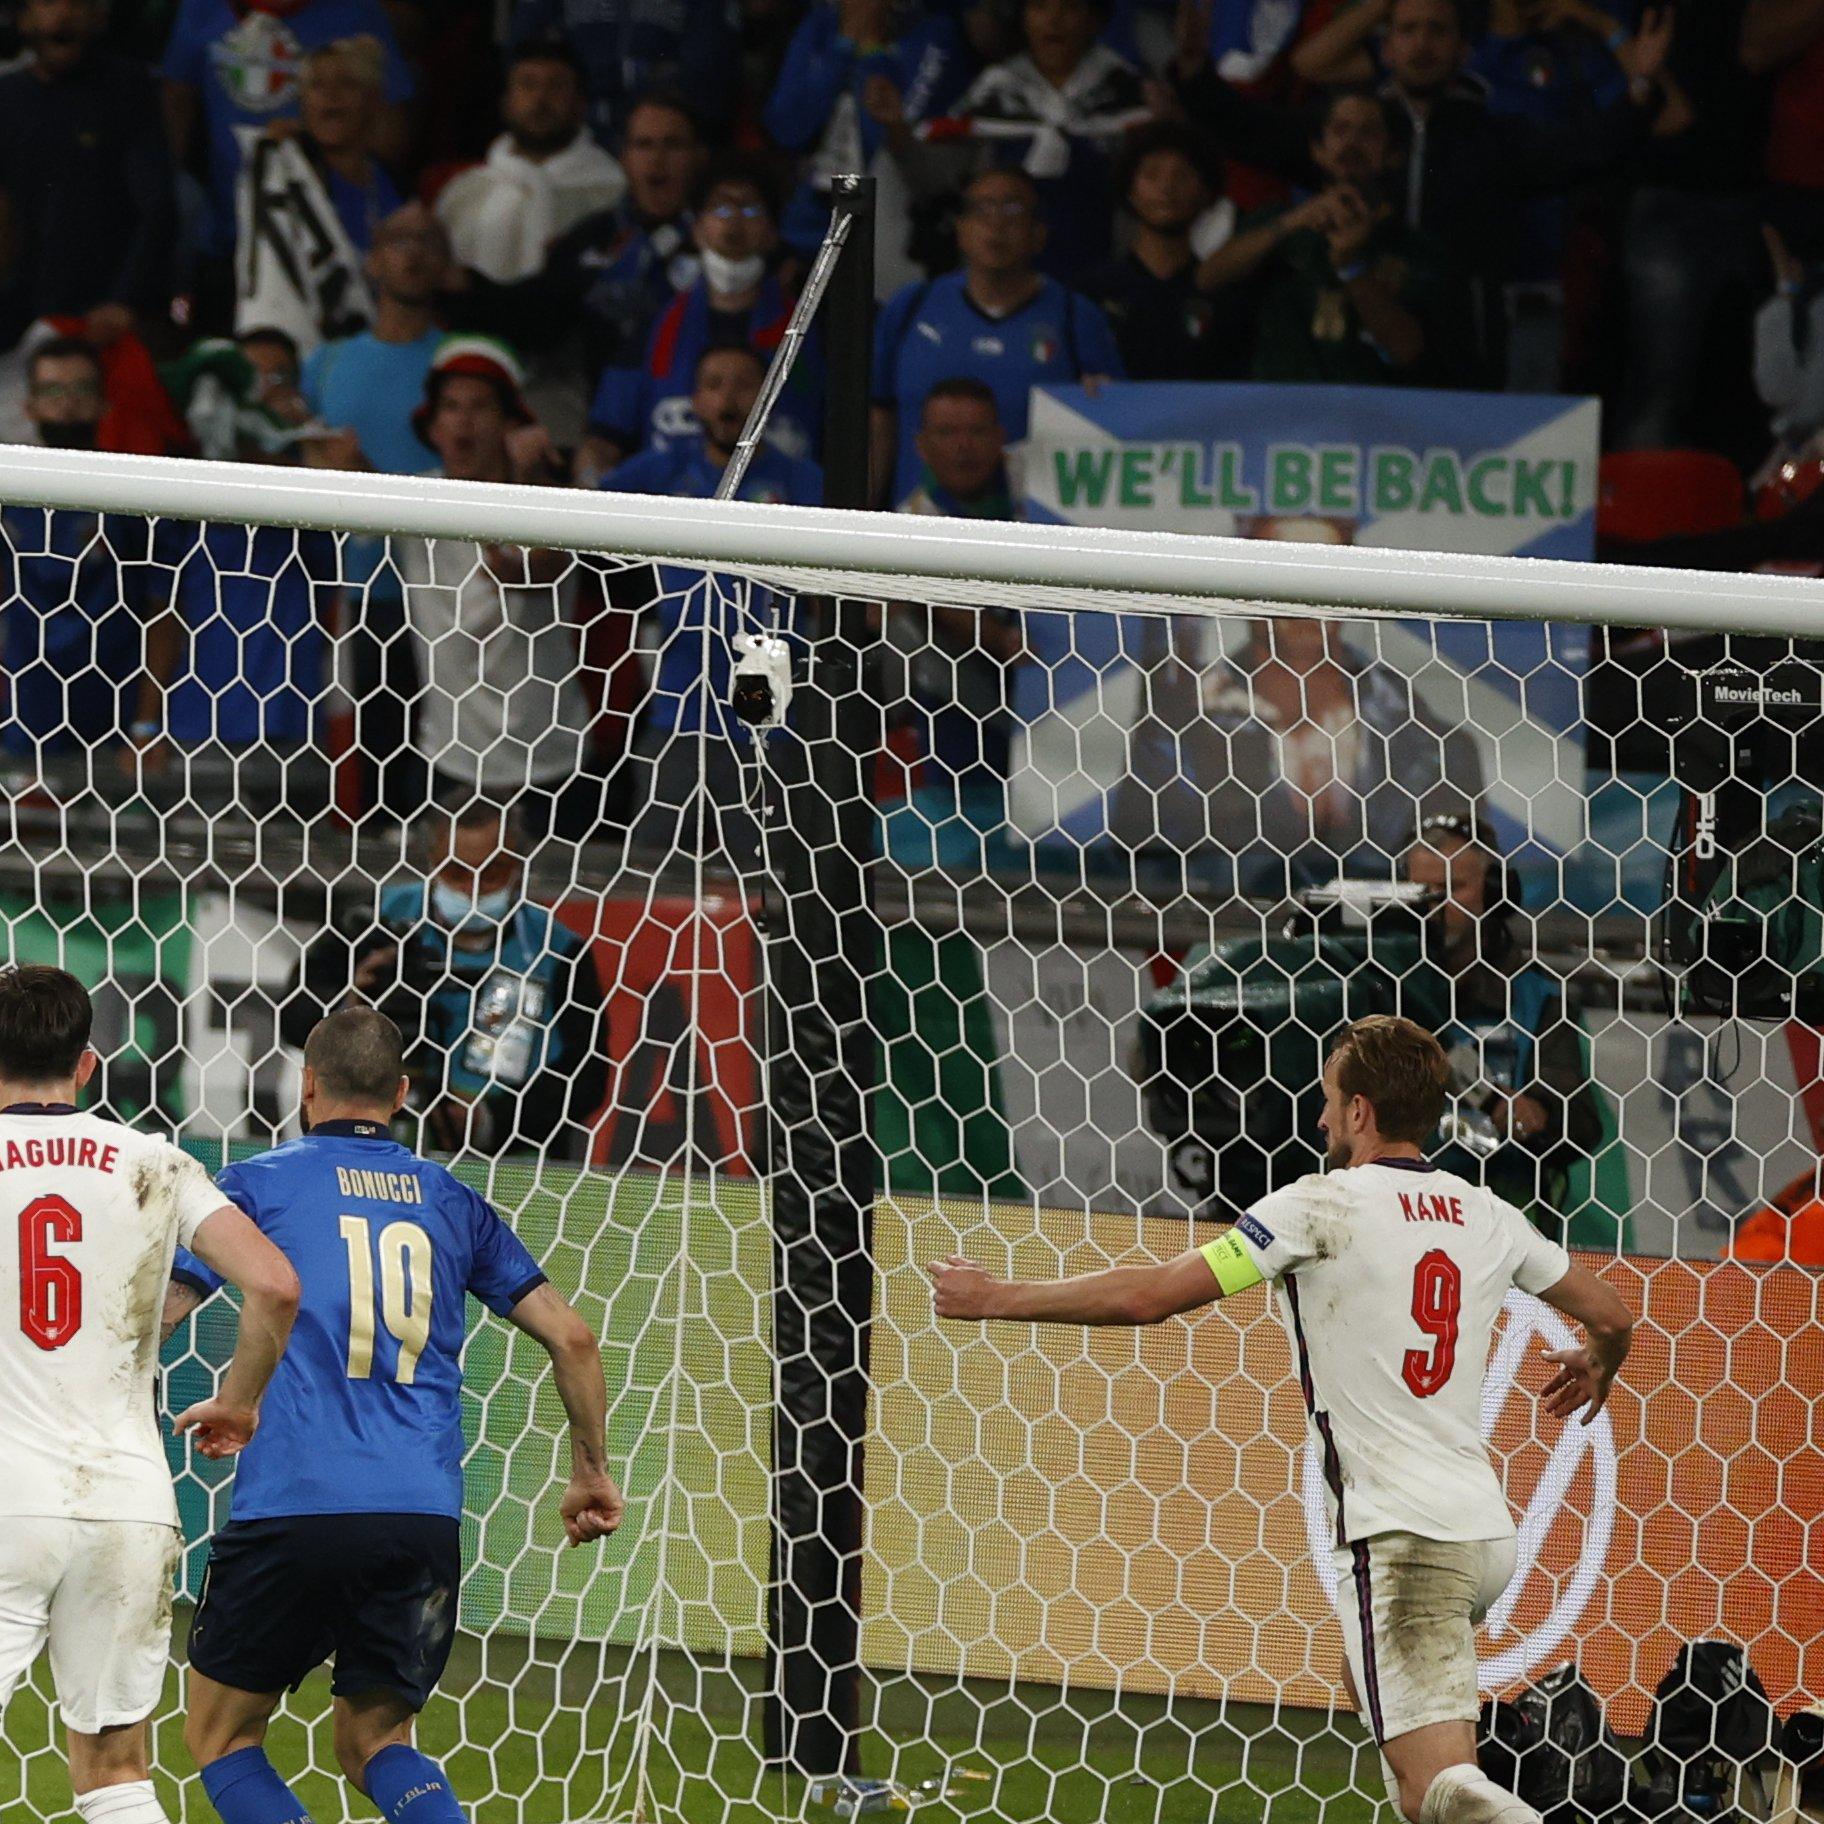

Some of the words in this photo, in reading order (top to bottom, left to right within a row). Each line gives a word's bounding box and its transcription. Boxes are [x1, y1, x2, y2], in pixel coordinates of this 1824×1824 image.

[1054, 450, 1256, 508] WE'LL
[1276, 450, 1357, 509] BE
[1377, 454, 1578, 519] BACK!
[1714, 686, 1802, 703] MovieTech
[336, 1166, 423, 1204] BONUCCI
[1397, 1192, 1465, 1227] KANE
[18, 1193, 83, 1351] 6
[339, 1215, 433, 1384] 19
[1401, 1248, 1462, 1399] 9
